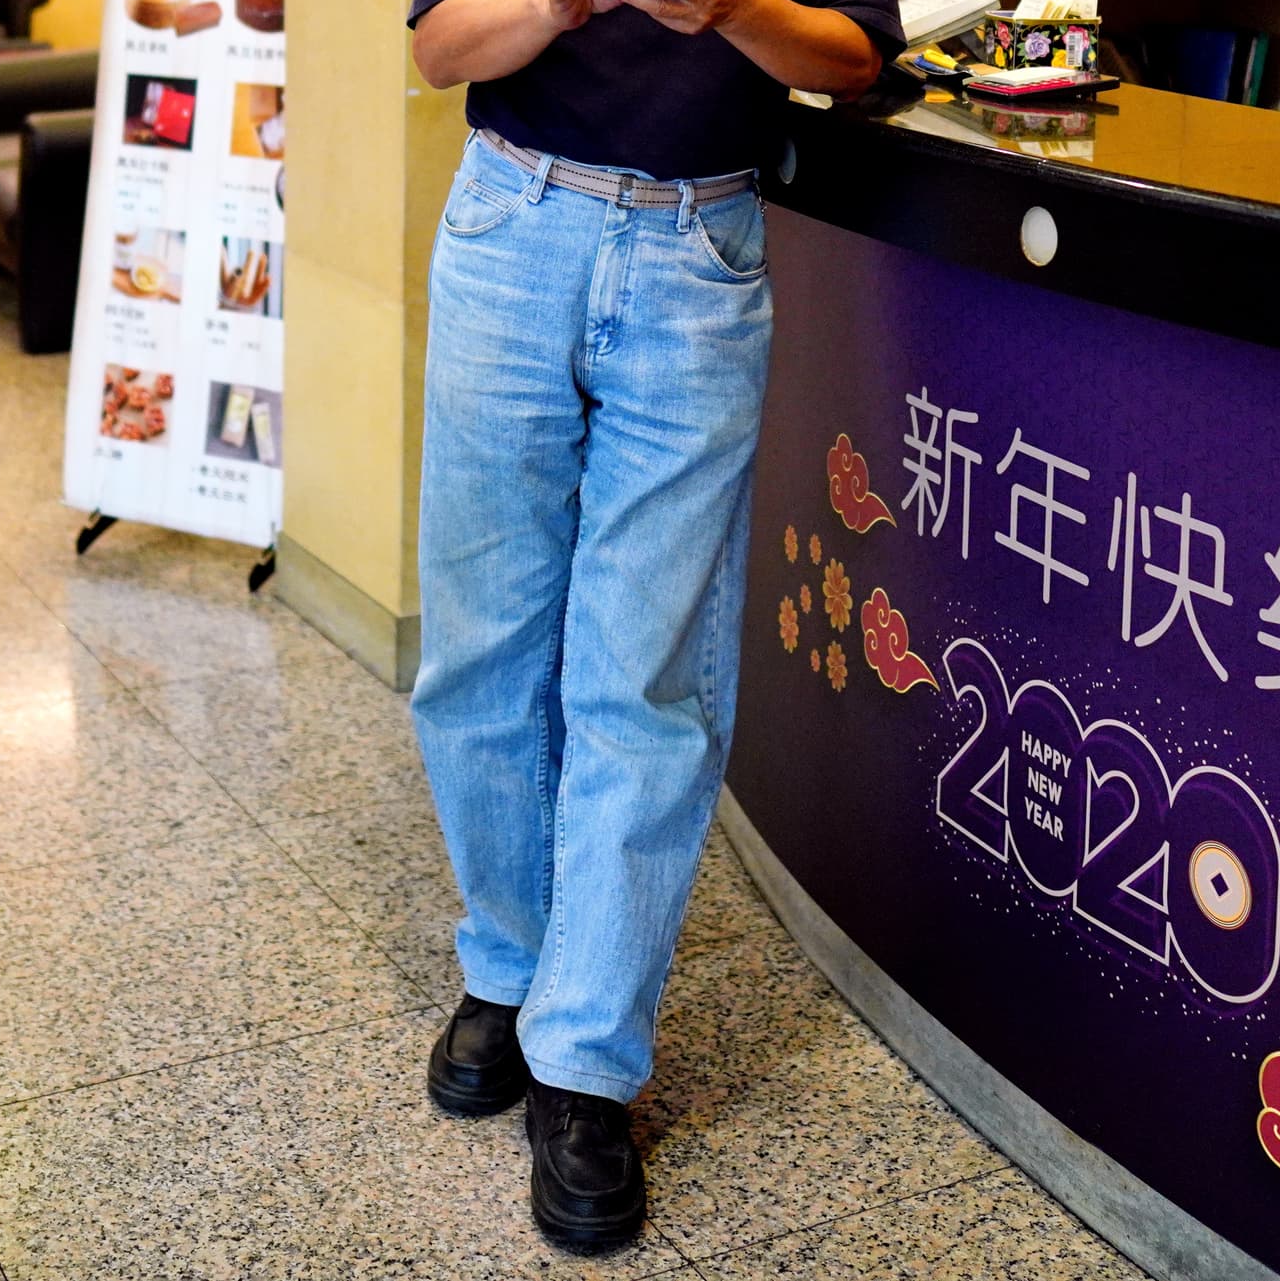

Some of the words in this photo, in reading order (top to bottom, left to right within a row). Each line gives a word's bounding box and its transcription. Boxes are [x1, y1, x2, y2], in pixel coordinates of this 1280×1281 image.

[1021, 729, 1072, 778] HAPPY
[1027, 766, 1062, 806] NEW
[1024, 796, 1064, 842] YEAR
